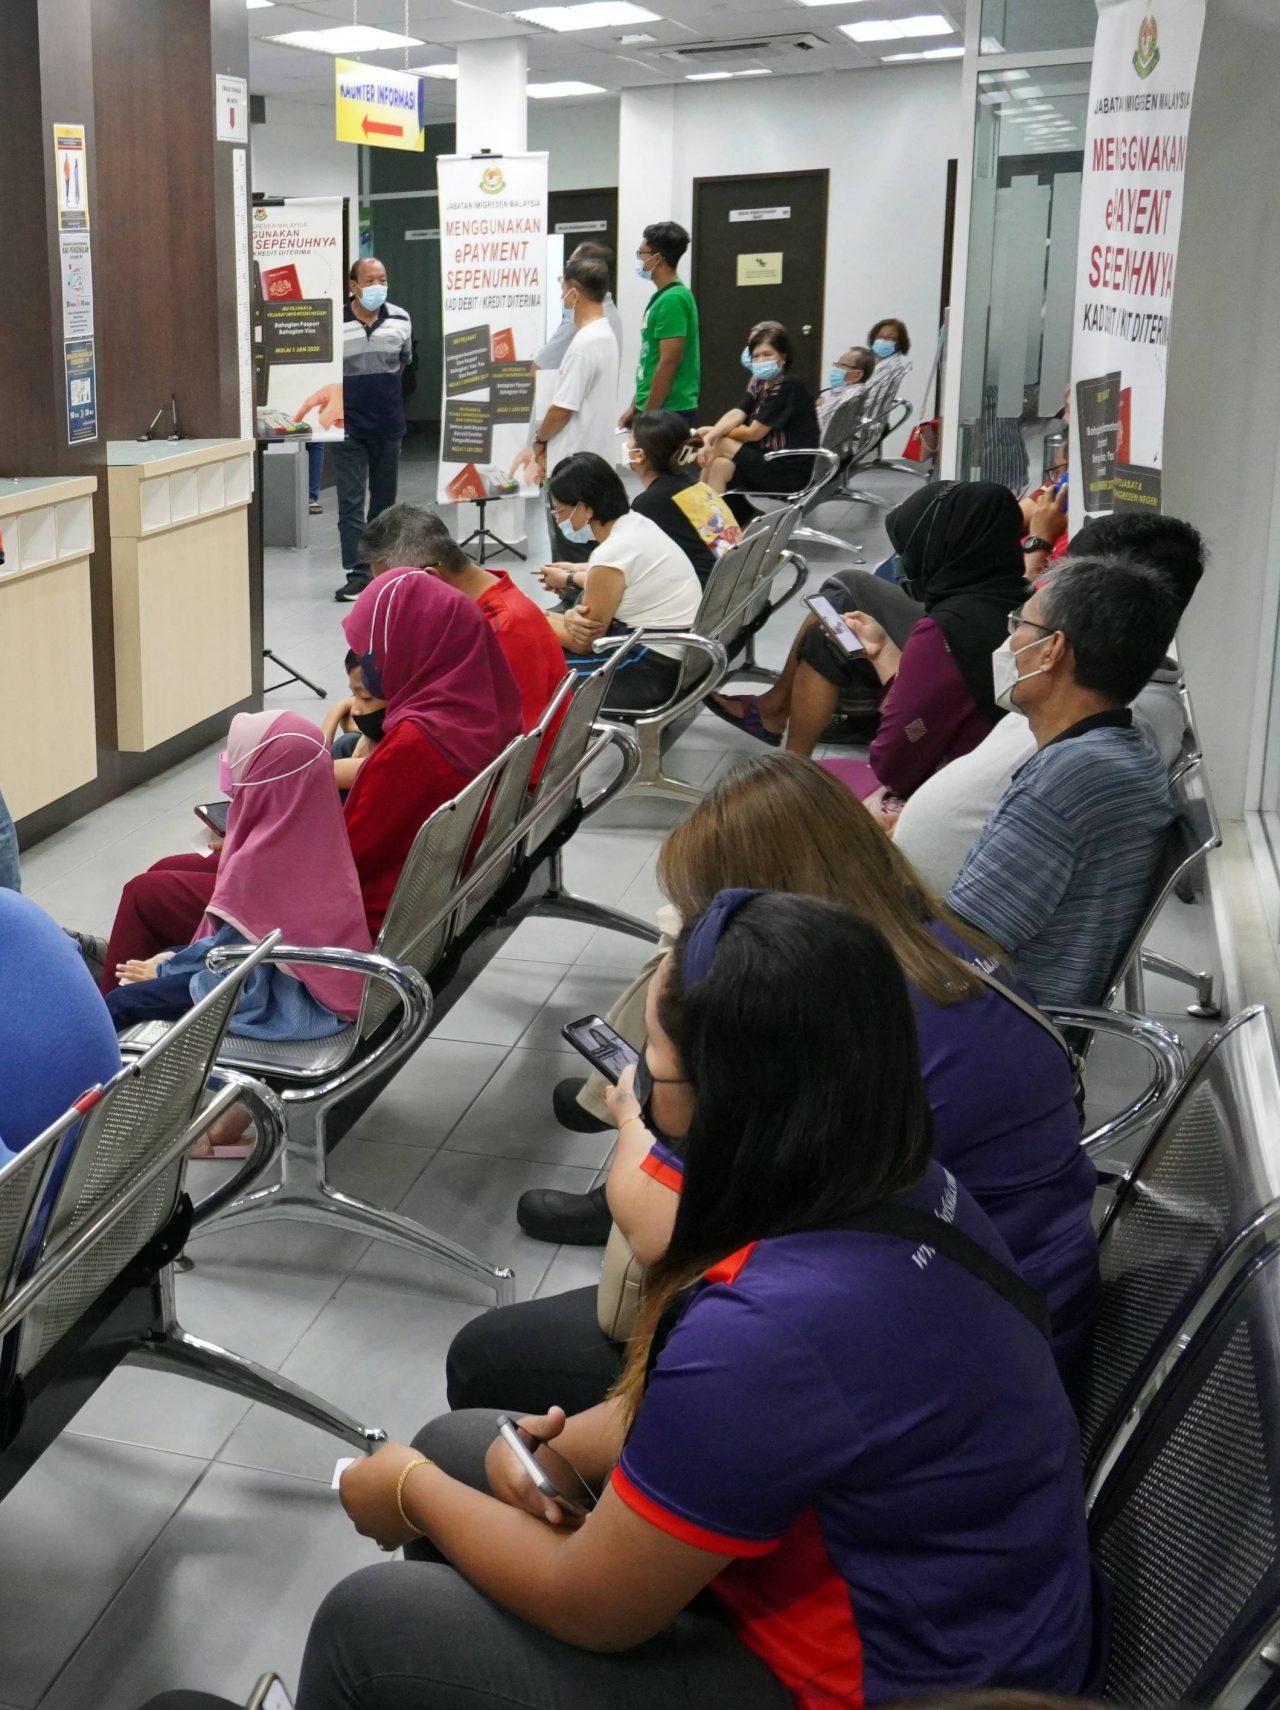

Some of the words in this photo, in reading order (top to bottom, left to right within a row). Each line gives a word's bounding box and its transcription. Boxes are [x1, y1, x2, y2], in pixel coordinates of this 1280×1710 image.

[340, 84, 375, 102] KAUNTER
[377, 85, 416, 110] INFORMASI
[1159, 91, 1190, 110] MALAYSIA
[446, 201, 473, 211] JABATAN
[474, 200, 508, 209] IMIGRESEN
[509, 199, 541, 208] MALAYSIA
[446, 218, 541, 237] MENGGUNAKAN
[255, 237, 337, 250] SEPENUHNYA
[455, 241, 529, 263] ePAYMENT
[446, 267, 539, 291] SEPENUHNYA
[445, 298, 457, 311] KAD
[458, 296, 478, 310] DEBIT
[482, 295, 507, 309] KREDIT
[507, 294, 541, 308] DITERIMA
[1083, 303, 1104, 332] KAD
